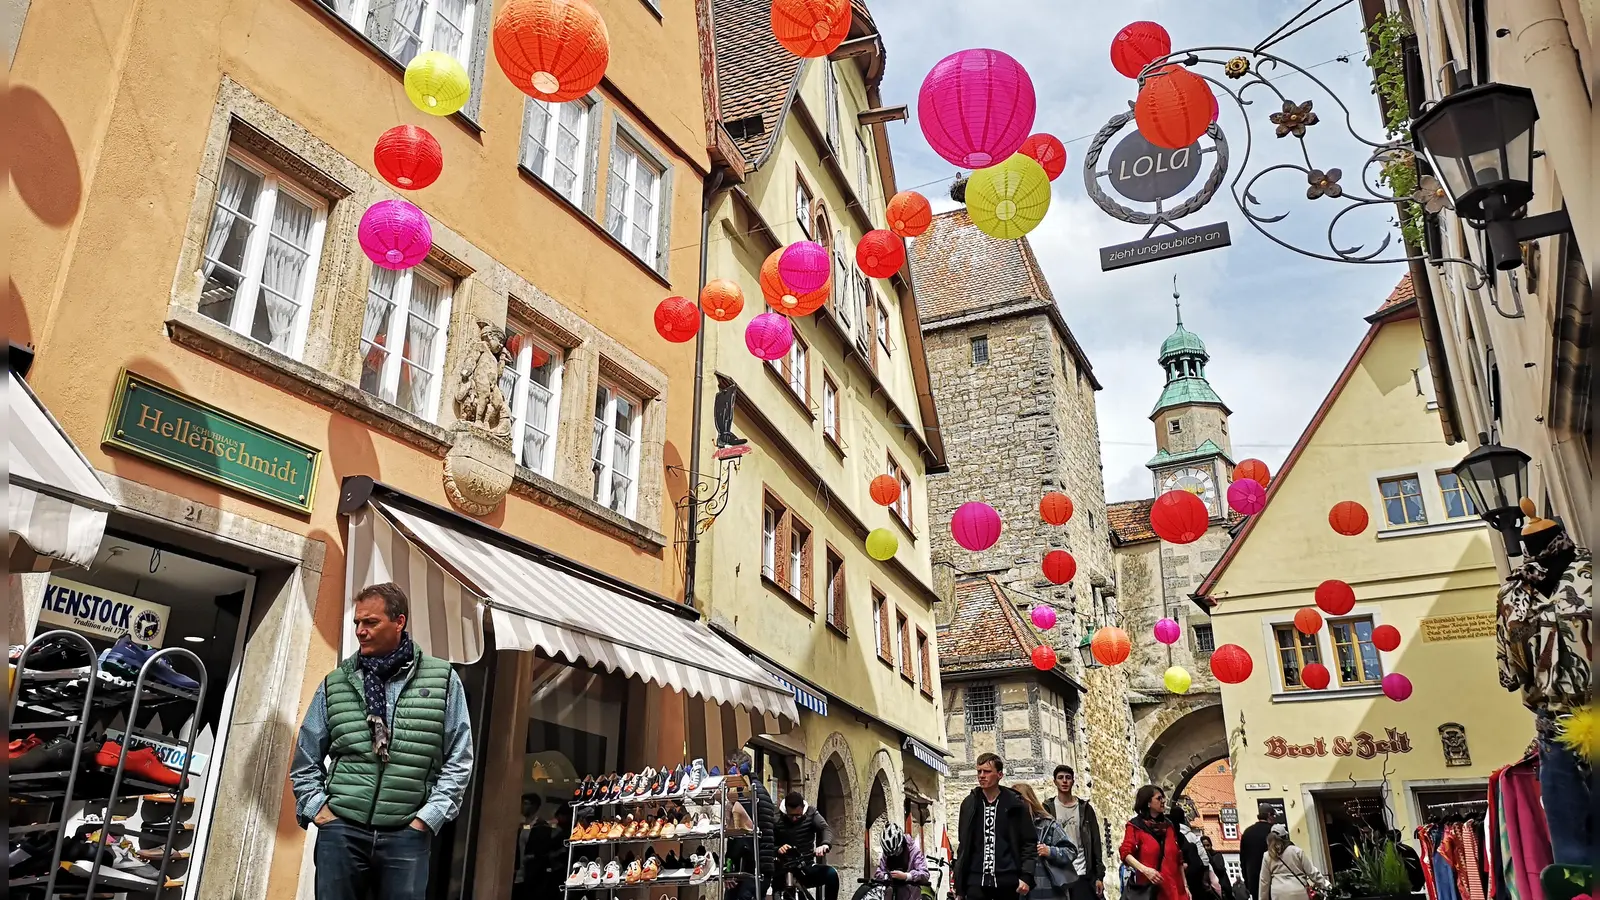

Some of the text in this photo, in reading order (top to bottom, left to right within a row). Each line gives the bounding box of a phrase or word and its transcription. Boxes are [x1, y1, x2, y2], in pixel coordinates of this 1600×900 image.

[1109, 231, 1221, 261] zieht unglaublich an
[136, 403, 298, 485] Hellenschmidt
[192, 424, 239, 447] SCHUHHAUS
[184, 505, 203, 523] 21
[73, 617, 101, 630] Tradition
[101, 625, 113, 633] seit
[1263, 726, 1413, 760] Brot & Zeit
